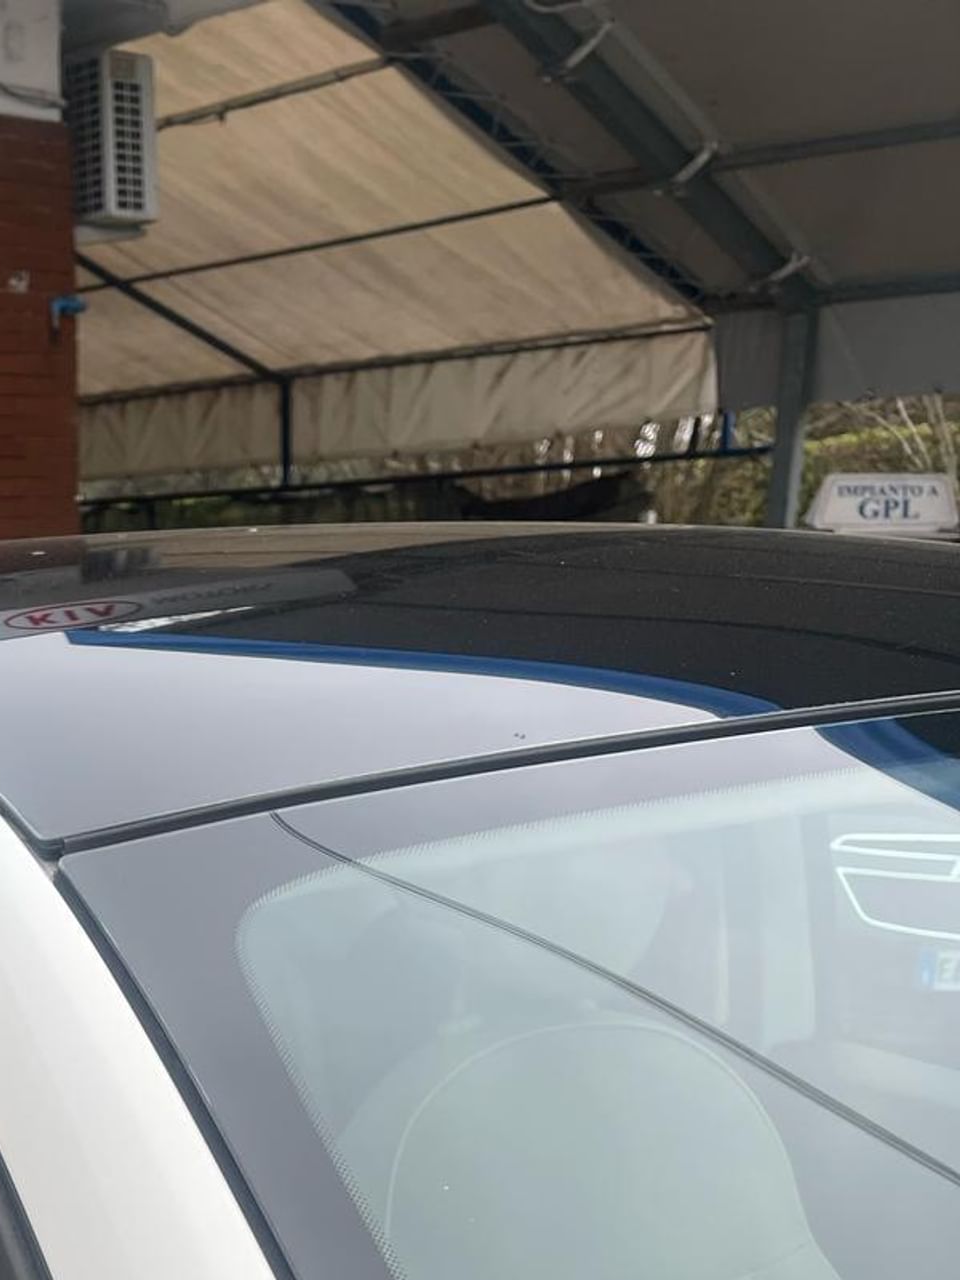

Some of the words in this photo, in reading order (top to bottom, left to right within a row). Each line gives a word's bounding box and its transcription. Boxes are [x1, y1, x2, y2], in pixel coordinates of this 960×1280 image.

[837, 485, 922, 497] IMPIANTO
[927, 484, 939, 496] A
[858, 498, 921, 520] GPL
